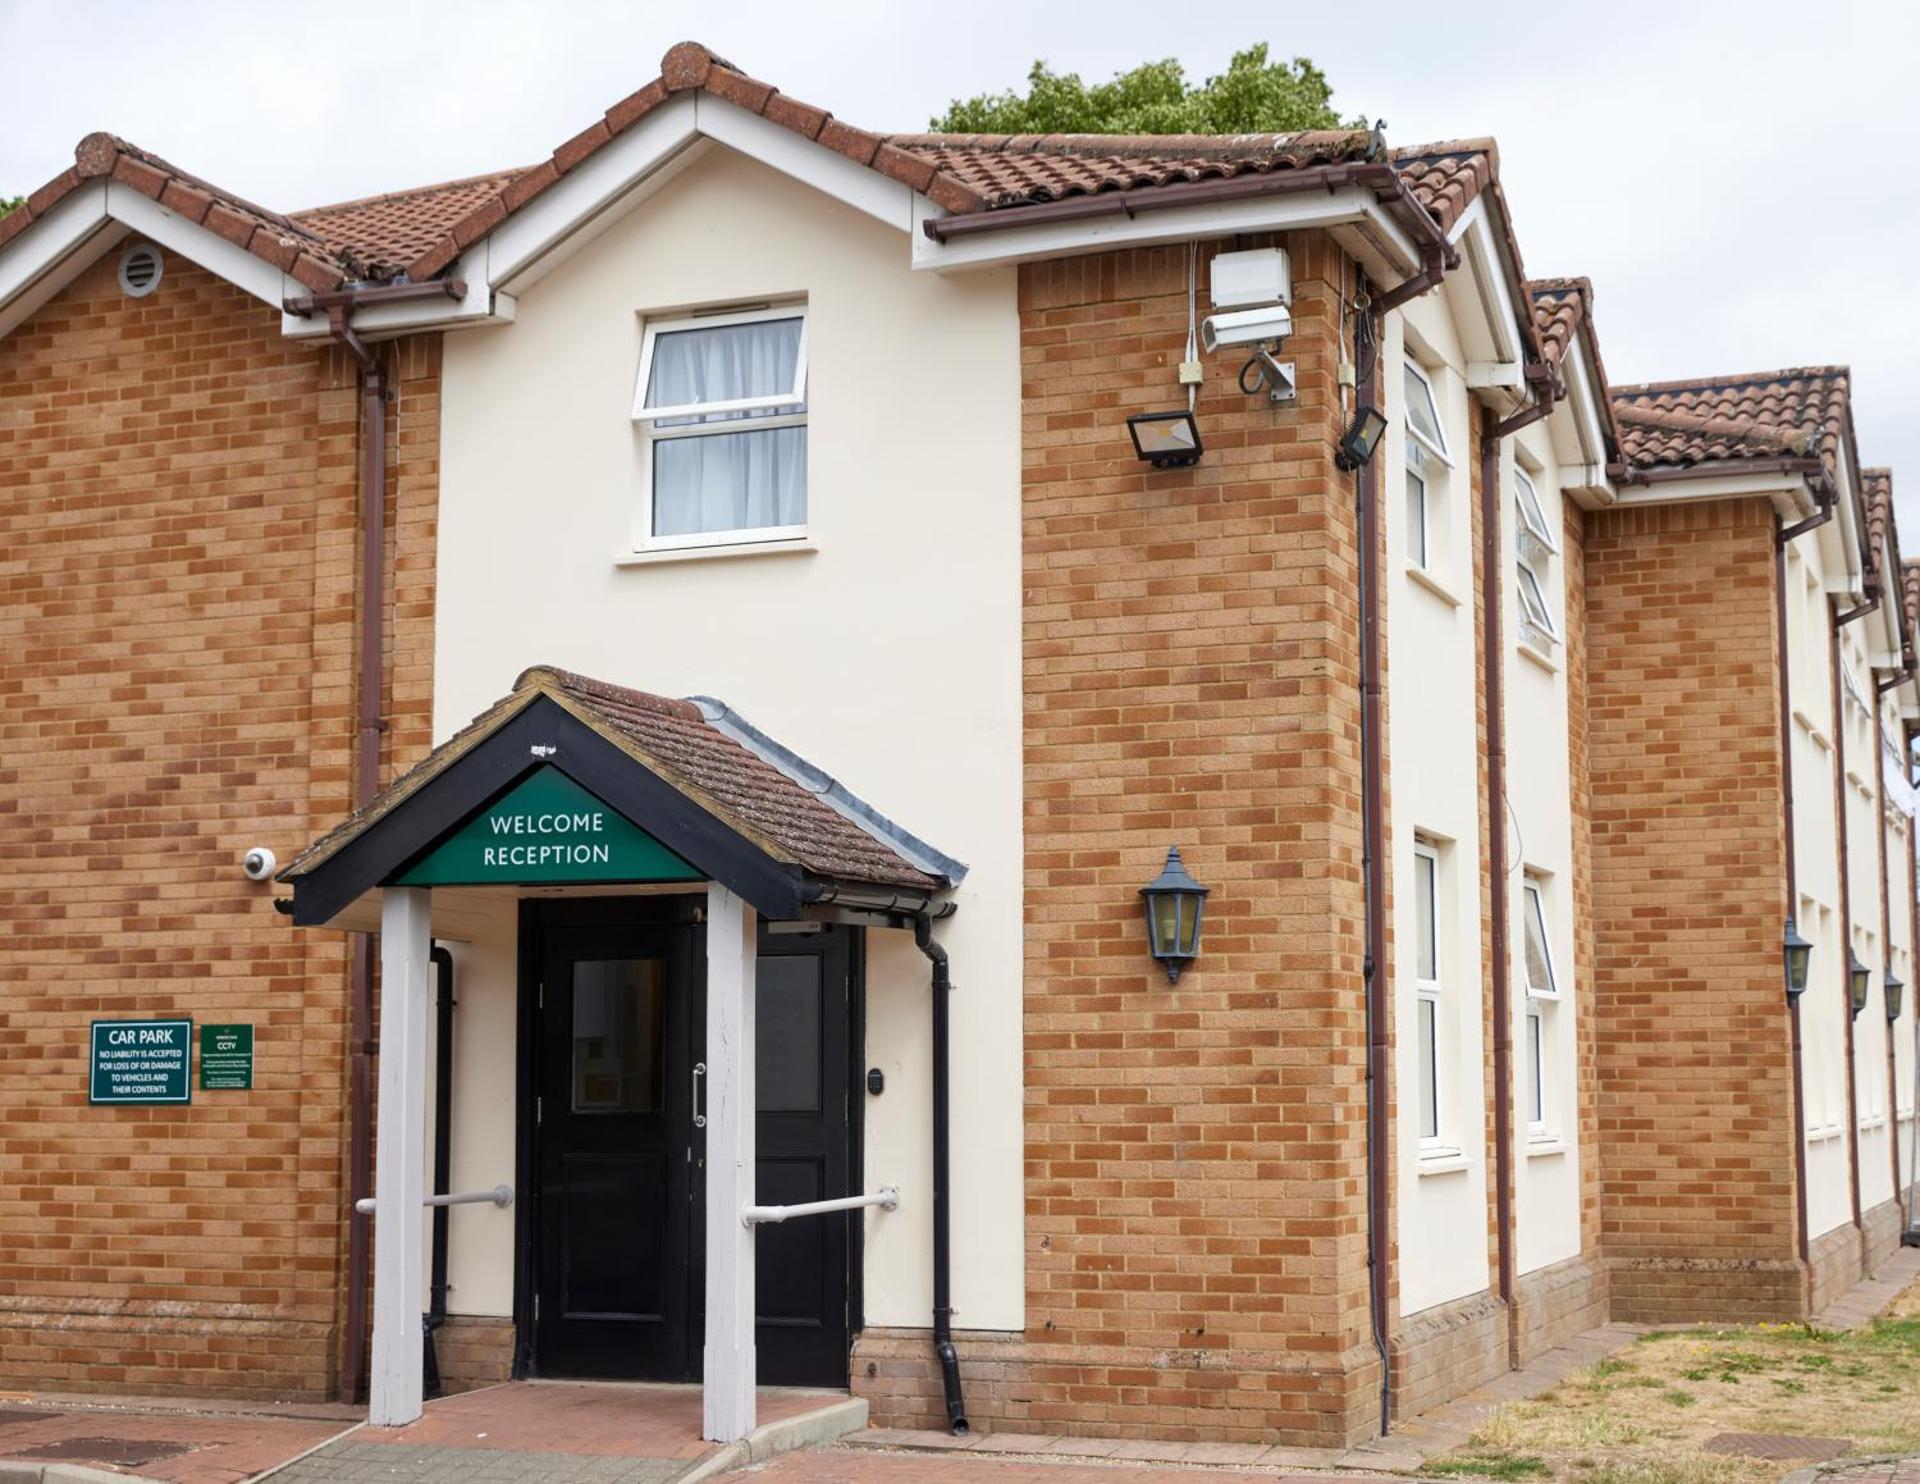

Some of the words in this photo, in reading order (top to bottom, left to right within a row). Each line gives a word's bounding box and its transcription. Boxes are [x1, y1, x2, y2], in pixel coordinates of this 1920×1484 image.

[490, 812, 603, 834] WELCOME
[484, 844, 609, 866] RECEPTION
[109, 1030, 136, 1044] CAR
[140, 1029, 173, 1044] PARK
[217, 1042, 236, 1050] CCTV
[99, 1051, 110, 1059] NO
[111, 1050, 140, 1058] LIABILITY
[140, 1050, 147, 1058] IS
[148, 1049, 182, 1058] ACCEPTED
[99, 1062, 112, 1071] FOR
[113, 1062, 130, 1070] LOSS
[130, 1062, 140, 1070] OF
[140, 1062, 150, 1070] OR
[151, 1061, 181, 1070] DAMAGE
[111, 1074, 121, 1082] TO
[121, 1073, 152, 1082] VEHICLES
[152, 1073, 168, 1081] AND
[112, 1086, 131, 1094] THEIR
[131, 1085, 167, 1093] CONTENTS
